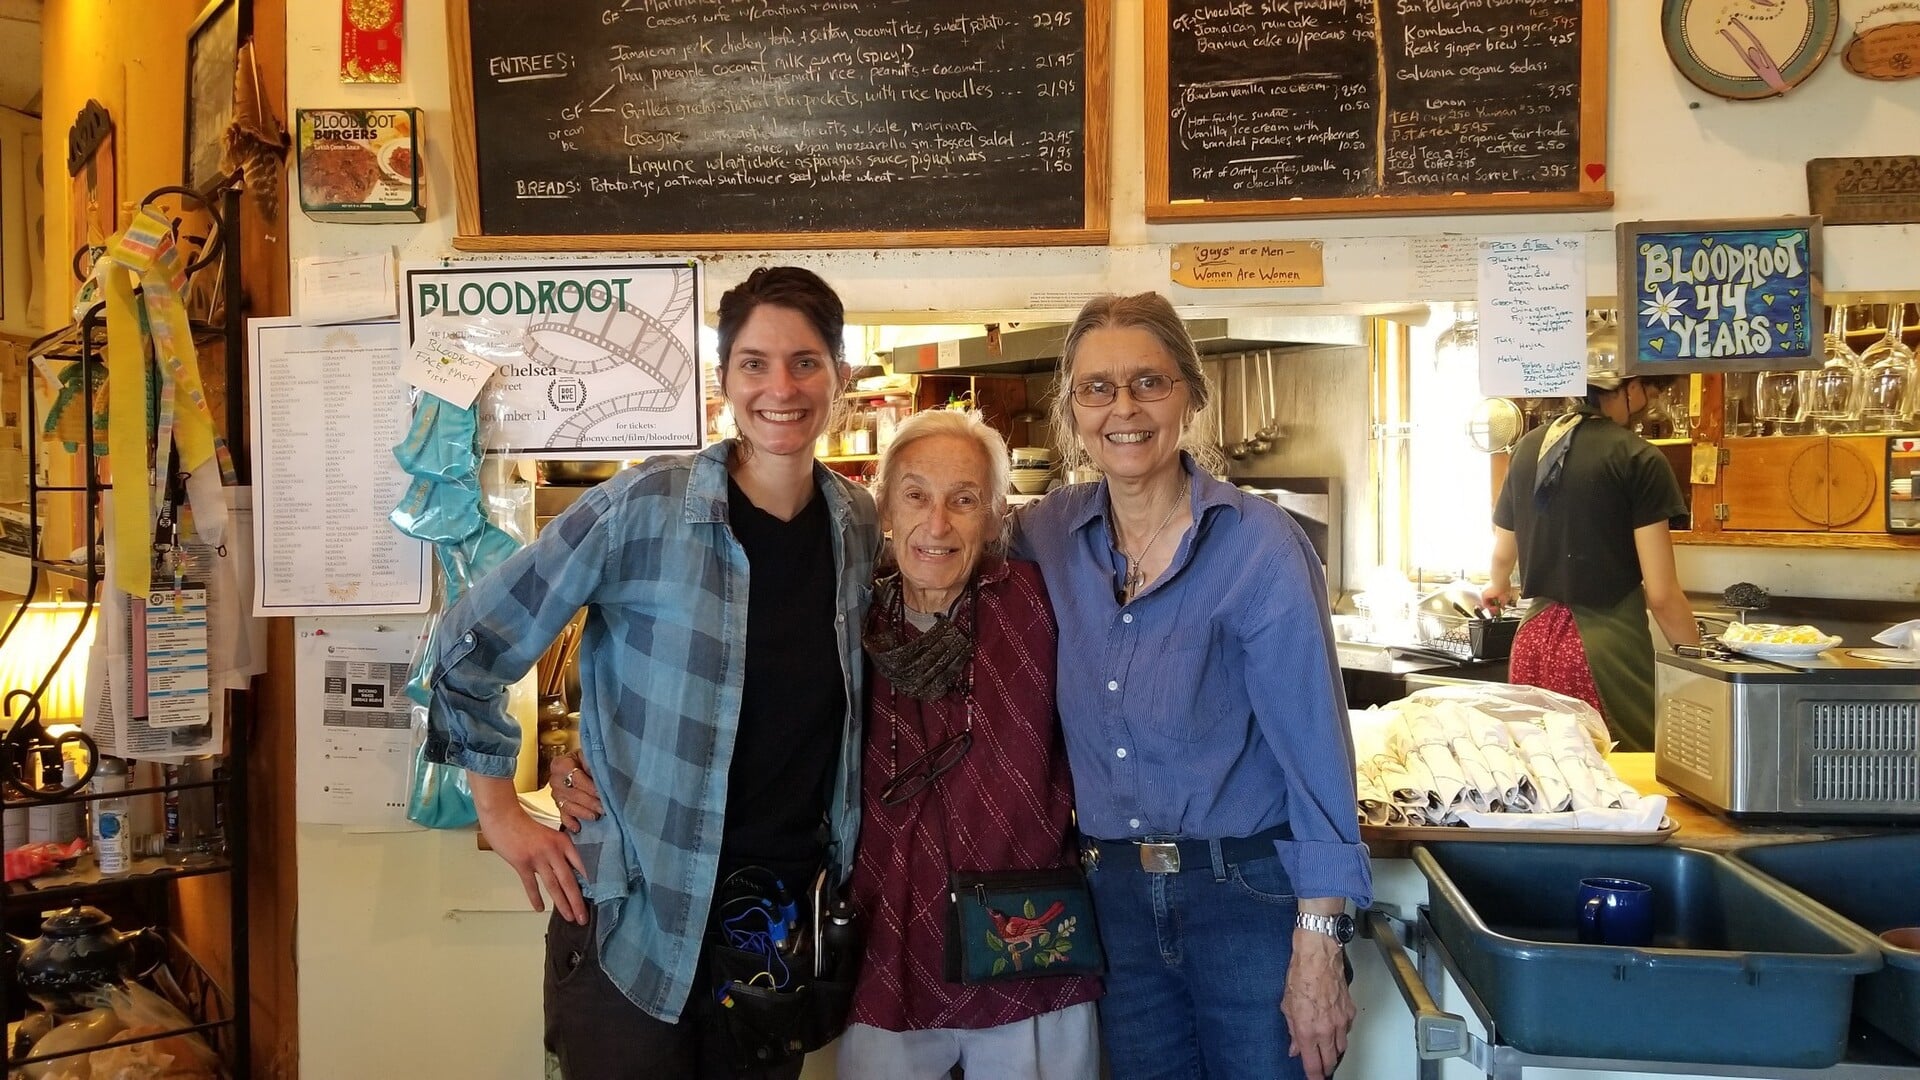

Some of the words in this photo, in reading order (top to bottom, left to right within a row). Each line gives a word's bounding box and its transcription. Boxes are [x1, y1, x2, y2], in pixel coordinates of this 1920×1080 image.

[646, 14, 698, 29] Caesars
[703, 6, 731, 22] wife
[739, 4, 806, 22] w/croutons
[1193, 3, 1255, 21] Chocolate
[1261, 0, 1291, 15] silk
[1396, 0, 1422, 15] San
[608, 45, 677, 61] Jamaican
[681, 35, 714, 61] jerk
[853, 17, 897, 38] coconut
[933, 14, 969, 35] sweet
[970, 17, 1004, 35] potato
[1194, 22, 1256, 37] Jamaican
[1404, 20, 1484, 43] Kombucha
[1499, 21, 1545, 42] ginger
[1198, 36, 1250, 53] Banana
[1253, 32, 1283, 47] cake
[1286, 30, 1346, 54] w/pecans
[1404, 40, 1440, 59] Reed's
[1444, 42, 1481, 58] ginger
[1485, 38, 1517, 51] brew
[1549, 32, 1576, 48] 4.25
[489, 53, 577, 77] ENTREES:
[611, 63, 643, 84] Thai
[651, 62, 708, 91] pineapple
[712, 54, 768, 76] coconut
[775, 52, 805, 70] milk
[810, 51, 853, 68] curry
[856, 43, 914, 64] (spicy!)
[869, 64, 919, 86] peanuts
[932, 58, 986, 76] coconut
[1459, 61, 1505, 81] organic
[621, 96, 672, 119] Grilled
[866, 84, 896, 103] with
[902, 84, 931, 101] rice
[934, 78, 994, 100] noodles
[1037, 79, 1077, 98] 21.95
[1186, 87, 1230, 103] Bourbon
[1231, 83, 1266, 98] vanilla
[1548, 83, 1574, 99] 3.95
[561, 101, 585, 121] GF
[1340, 101, 1370, 112] 10.50
[313, 114, 396, 129] BLOODOOT
[1188, 115, 1211, 128] Hot
[1211, 113, 1248, 128] fudge
[1251, 107, 1290, 121] sundae
[1294, 119, 1320, 132] with
[1391, 110, 1420, 123] TEA
[1423, 112, 1447, 125] cup
[313, 129, 378, 140] BURGERS
[624, 125, 684, 152] Lasagne
[911, 119, 978, 132] marinara
[745, 143, 789, 156] sauce,
[795, 141, 829, 156] vegan
[935, 133, 974, 149] tossed
[978, 131, 1015, 148] salad
[1251, 135, 1292, 151] peaches
[1307, 127, 1360, 145] raspberries
[1459, 132, 1507, 149] organic
[1511, 127, 1535, 140] fair
[1535, 119, 1571, 137] trade
[562, 140, 579, 151] be
[1338, 141, 1366, 152] 10.50
[1386, 147, 1417, 160] Iced
[1418, 147, 1442, 160] Tea
[1486, 141, 1528, 154] coffee
[1535, 140, 1567, 152] 2.50
[628, 155, 697, 178] Linguine
[1192, 166, 1214, 180] Pint
[1218, 165, 1228, 178] of
[1301, 158, 1337, 172] vanilla
[1388, 159, 1415, 170] Iced
[1539, 164, 1570, 177] 3.95
[516, 180, 582, 197] BREADS:
[820, 170, 852, 184] whole
[857, 171, 898, 183] wheat
[1044, 160, 1073, 173] 1.50
[1233, 180, 1244, 190] or
[1246, 174, 1294, 189] chocolate
[1239, 246, 1258, 257] are
[1639, 232, 1804, 293] BLOODROOT
[1192, 267, 1233, 281] Women
[1236, 267, 1256, 282] Are
[1259, 267, 1301, 281] Women
[418, 277, 633, 317] BLOODROOT
[1694, 282, 1749, 322] 44
[1669, 315, 1773, 359] YEARS
[1790, 304, 1806, 351] WOMYN
[427, 338, 481, 370] BLOODROOT
[415, 350, 442, 371] FACE
[448, 366, 479, 387] MASK
[499, 363, 557, 377] Chelsea
[616, 422, 627, 430] for
[628, 422, 657, 430] tickets:
